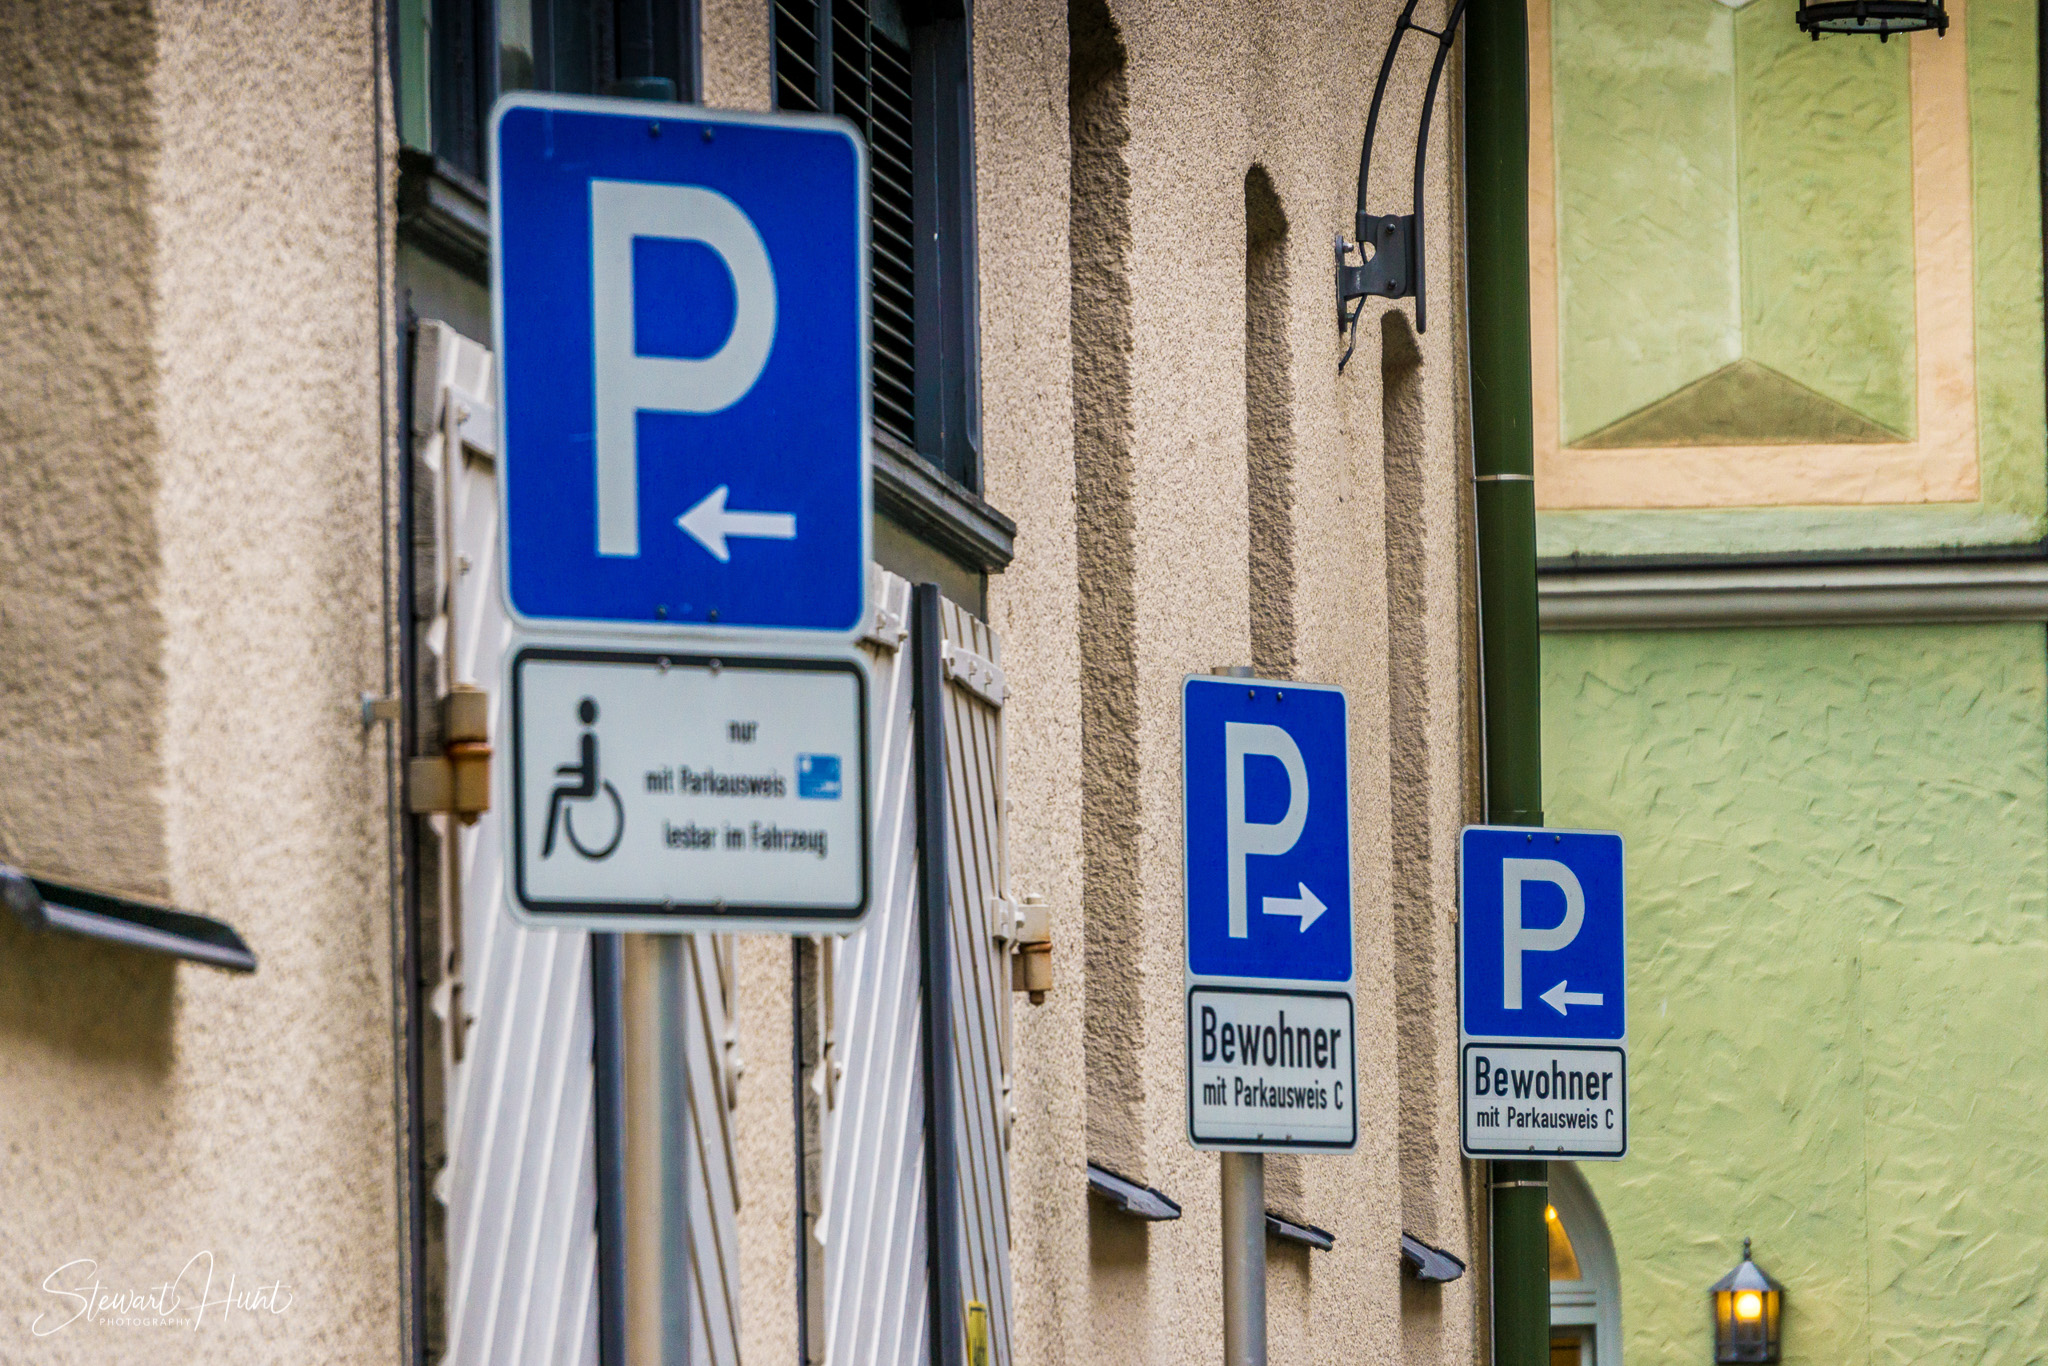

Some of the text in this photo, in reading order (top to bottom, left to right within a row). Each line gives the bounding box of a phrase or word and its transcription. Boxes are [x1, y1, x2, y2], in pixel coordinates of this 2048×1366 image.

[591, 177, 778, 557] P
[728, 720, 758, 743] nur
[646, 766, 787, 798] mit Parkausweis
[664, 820, 828, 859] lesbar im Fahrzeug
[1225, 721, 1309, 939] P
[1502, 858, 1586, 1010] P
[1201, 1005, 1341, 1069] Bewohner
[1203, 1075, 1344, 1110] mit Parkausweis C
[1475, 1056, 1614, 1101] Bewohner
[1477, 1106, 1614, 1129] mit Parkausweis C
